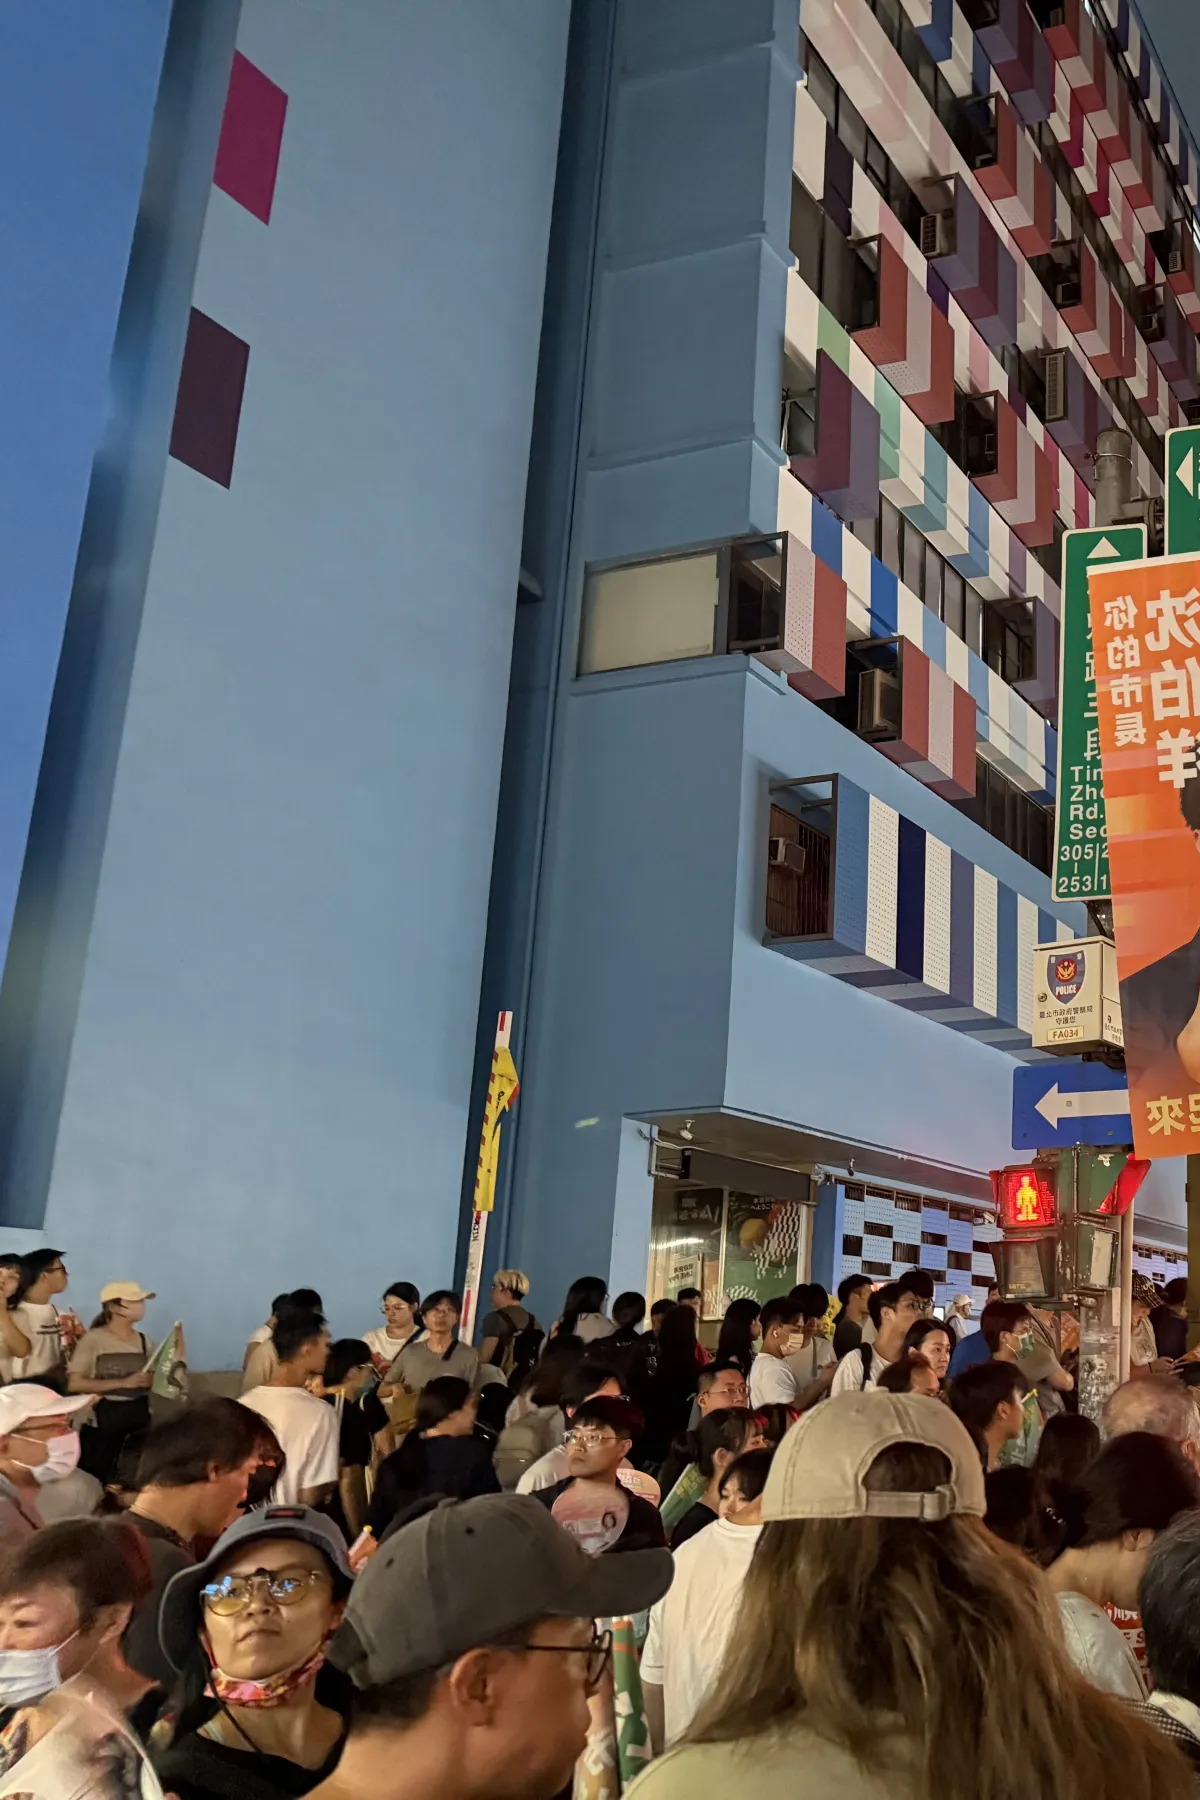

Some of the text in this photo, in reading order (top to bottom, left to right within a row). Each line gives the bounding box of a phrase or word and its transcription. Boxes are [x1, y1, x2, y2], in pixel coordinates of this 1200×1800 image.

[1070, 766, 1104, 783] Tin
[1069, 804, 1104, 820] Rd.
[1060, 846, 1094, 861] 305
[1058, 876, 1092, 893] 253
[1055, 984, 1077, 996] POLICE
[1053, 1029, 1079, 1039] FA034
